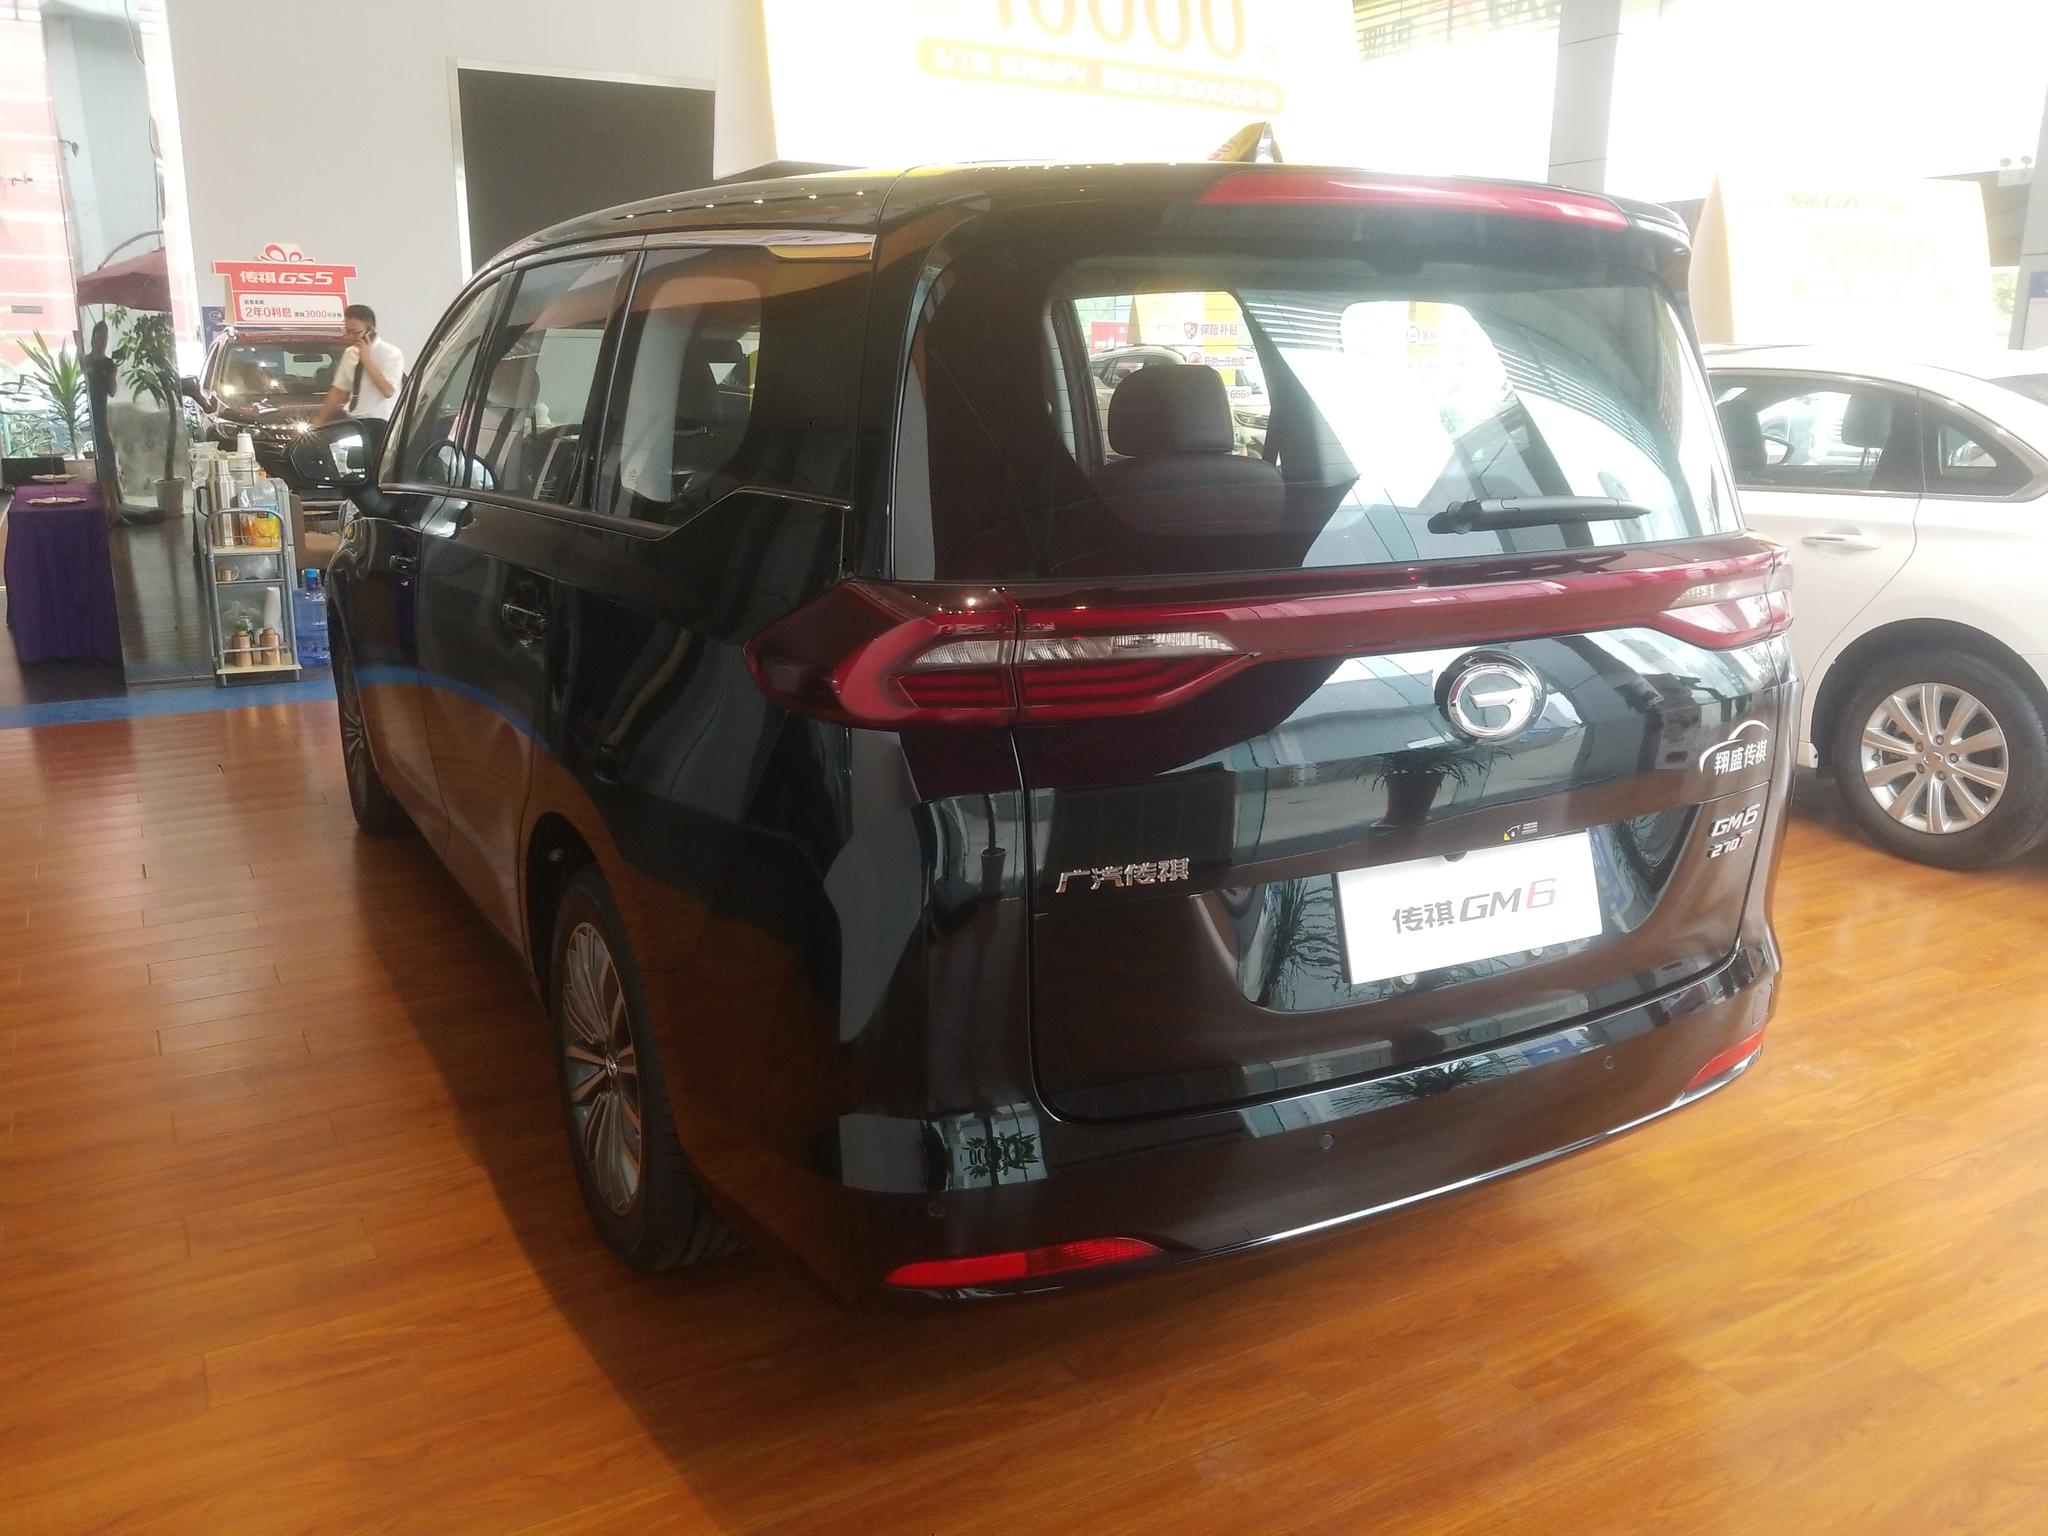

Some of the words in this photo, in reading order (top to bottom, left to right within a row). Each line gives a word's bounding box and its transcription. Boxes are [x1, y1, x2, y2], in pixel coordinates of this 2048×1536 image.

[1714, 739, 1768, 777] 翔盛传祺
[1711, 803, 1760, 837] GM6
[1709, 829, 1753, 858] 270T
[1055, 857, 1191, 894] 广汽传祺
